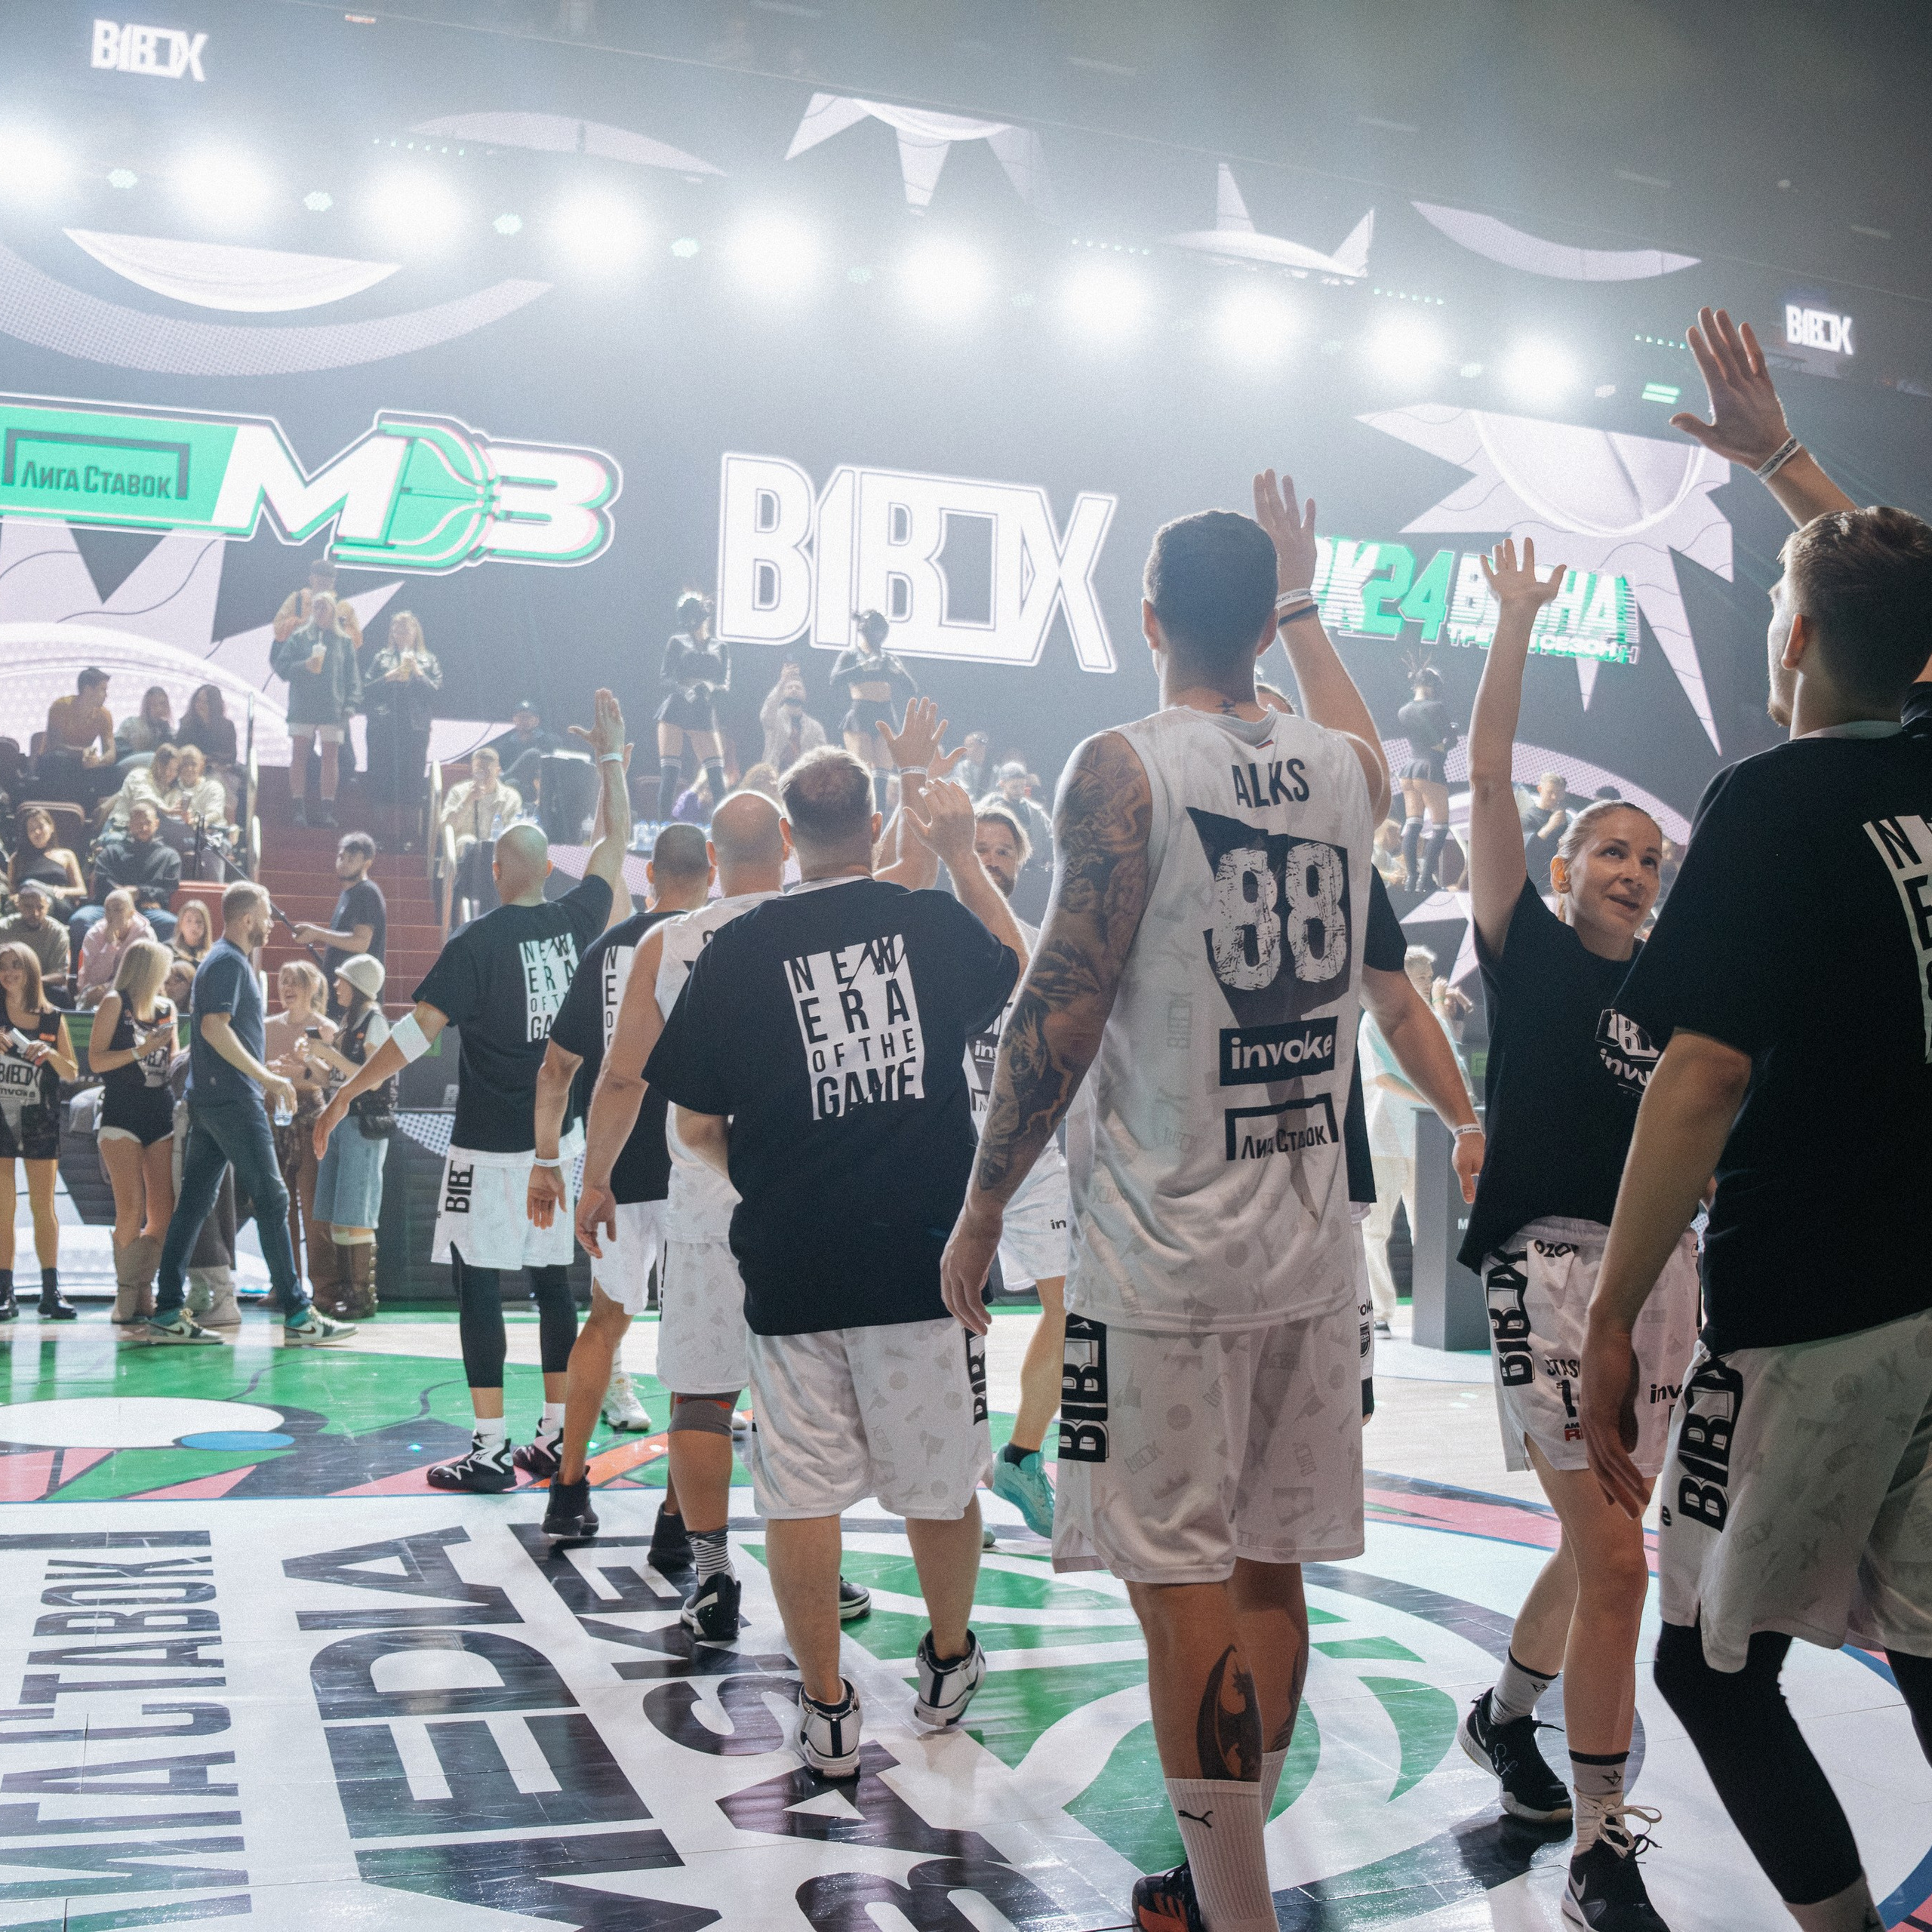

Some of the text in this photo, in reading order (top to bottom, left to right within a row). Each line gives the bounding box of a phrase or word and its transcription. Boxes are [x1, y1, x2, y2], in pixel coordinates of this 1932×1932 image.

[91, 19, 209, 82] BIBOX
[1785, 304, 1854, 356] BIBOX
[716, 451, 1118, 674] BIBOX
[1231, 758, 1310, 809] ALKS
[1210, 841, 1349, 992] 88
[792, 936, 906, 995] NEW
[531, 996, 547, 1014] OF
[798, 978, 911, 1044] ERA
[811, 1027, 917, 1073] OF THE
[1231, 1030, 1334, 1070] invoke
[1599, 1048, 1654, 1087] invo
[816, 1055, 918, 1118] GAME
[1544, 1359, 1580, 1378] STAS
